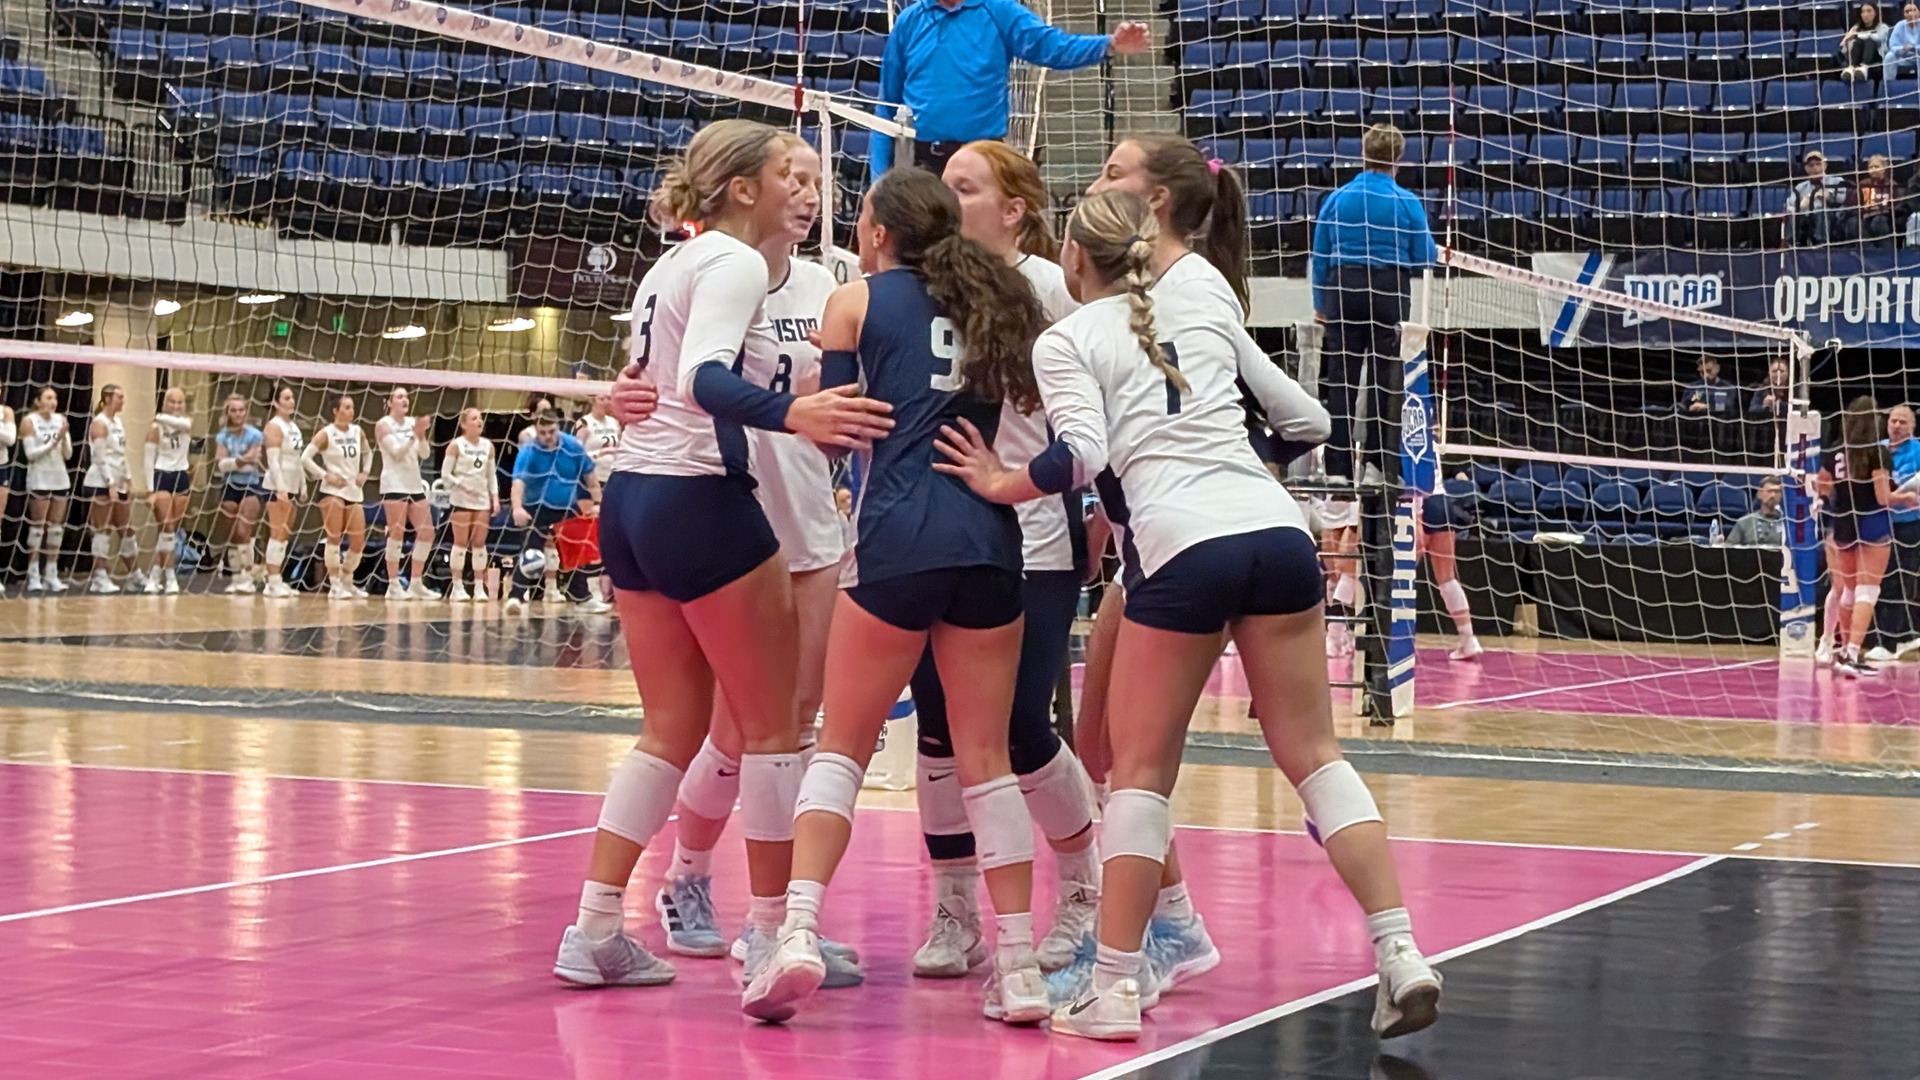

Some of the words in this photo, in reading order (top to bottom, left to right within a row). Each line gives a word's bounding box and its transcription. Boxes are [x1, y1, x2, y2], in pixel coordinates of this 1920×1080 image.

[637, 294, 657, 369] 3
[931, 316, 966, 391] 9
[1150, 342, 1182, 415] 1
[341, 445, 357, 459] 10
[473, 457, 483, 469] 6
